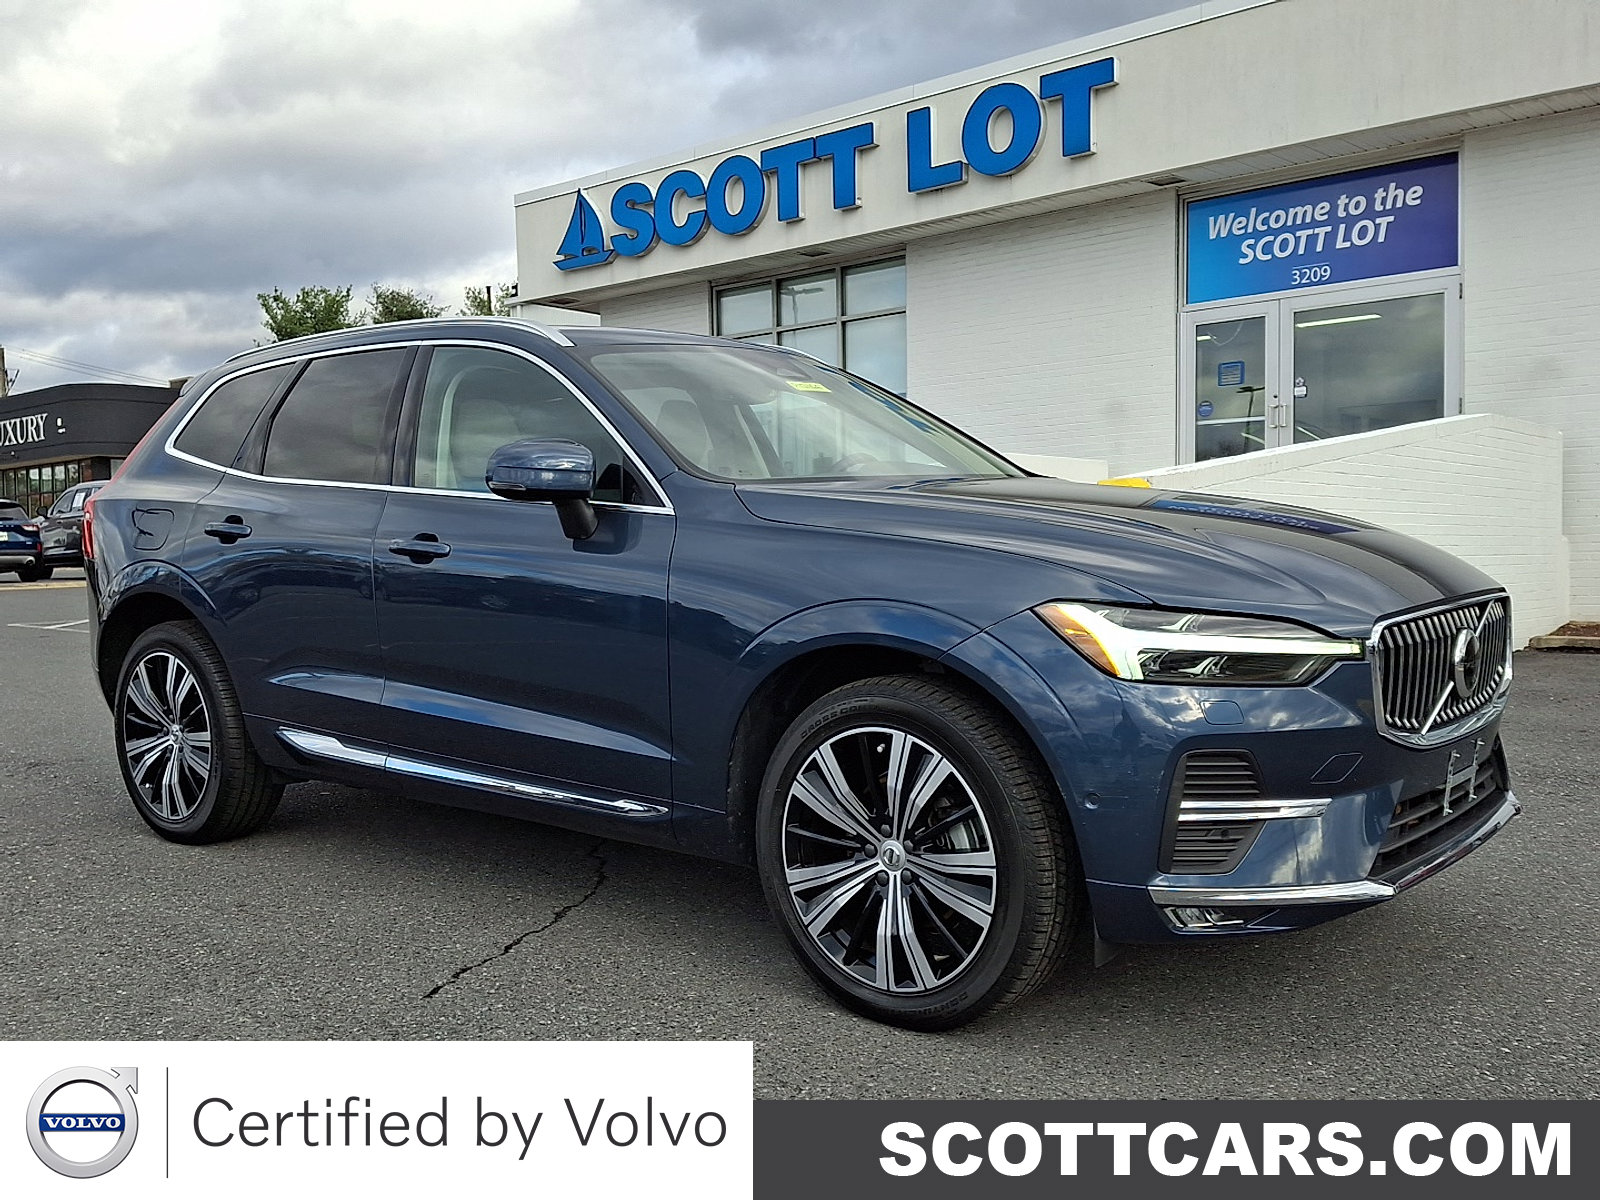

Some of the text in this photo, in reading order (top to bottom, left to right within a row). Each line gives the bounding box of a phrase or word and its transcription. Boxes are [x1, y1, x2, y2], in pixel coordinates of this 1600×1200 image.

[610, 57, 1116, 258] SCOTT LOT
[1208, 182, 1424, 240] Welcome to the
[1238, 216, 1395, 265] SCOTT LOT
[1291, 265, 1331, 285] 3209
